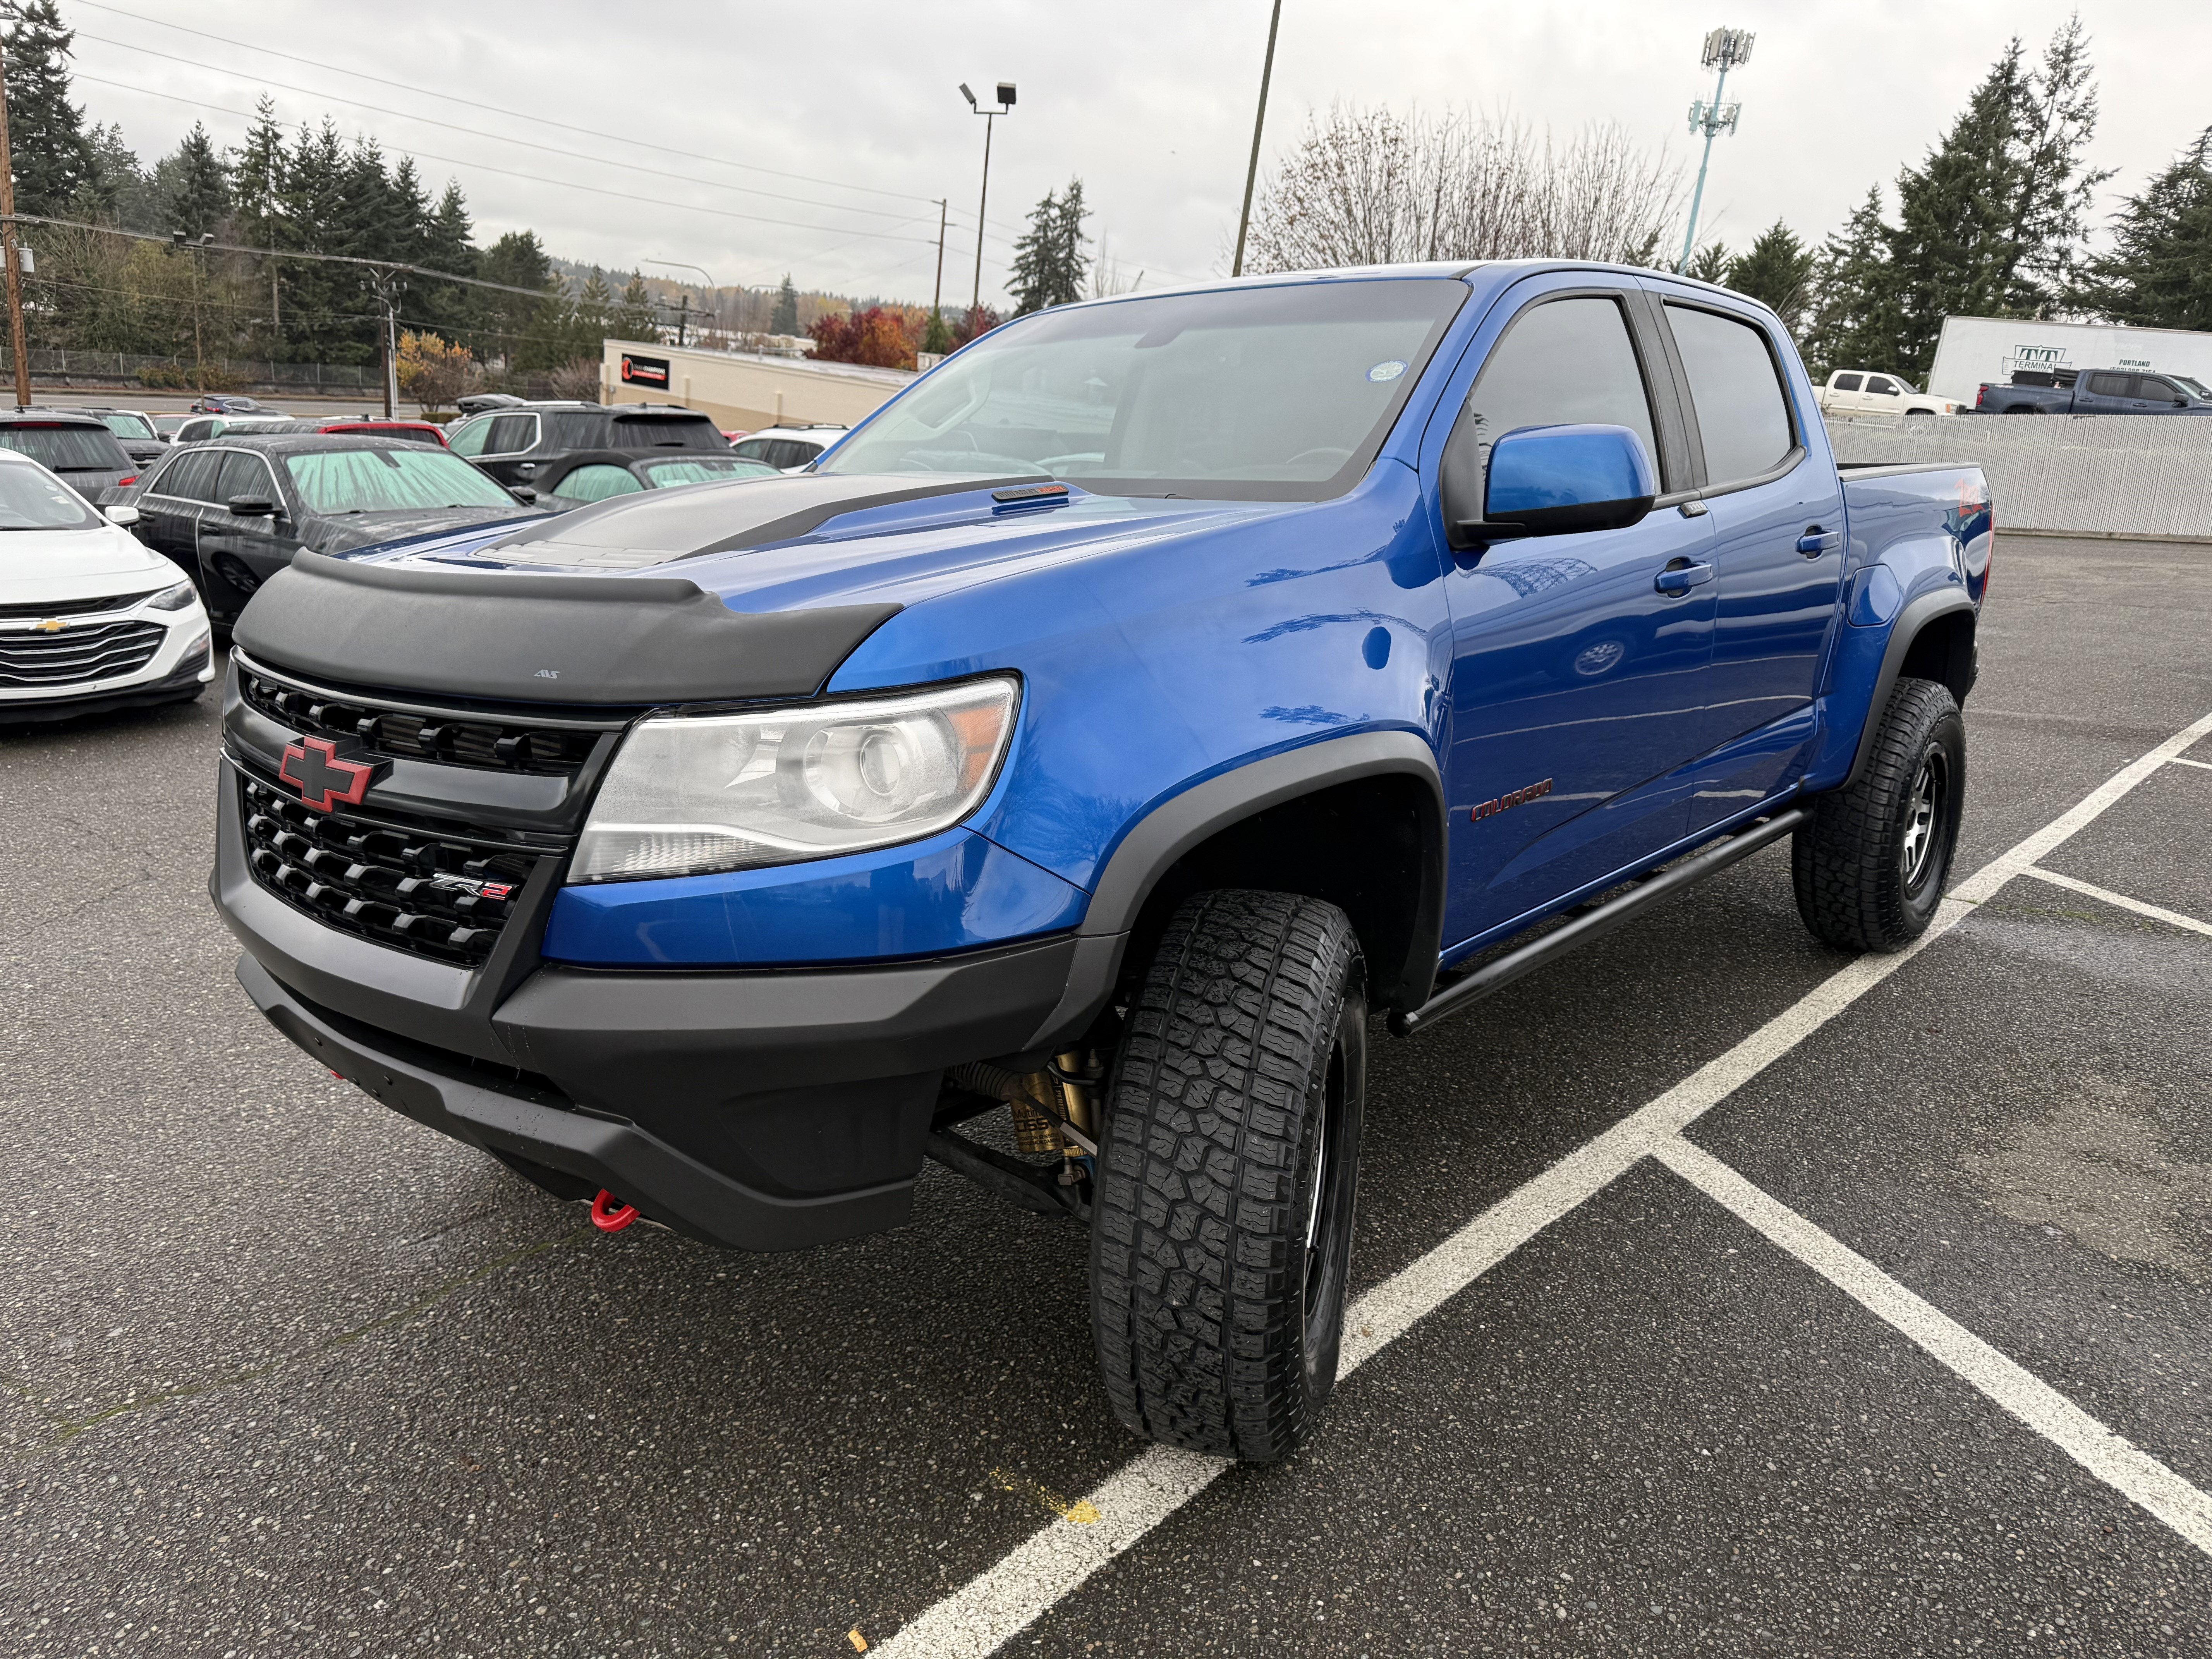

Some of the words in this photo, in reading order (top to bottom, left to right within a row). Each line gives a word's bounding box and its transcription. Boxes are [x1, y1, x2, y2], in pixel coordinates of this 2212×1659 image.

[2119, 359, 2150, 367] PORTLAND
[534, 669, 560, 679] AVS
[1471, 778, 1553, 822] COLORADO
[429, 873, 512, 900] ZR2
[1016, 1118, 1050, 1132] DSS
